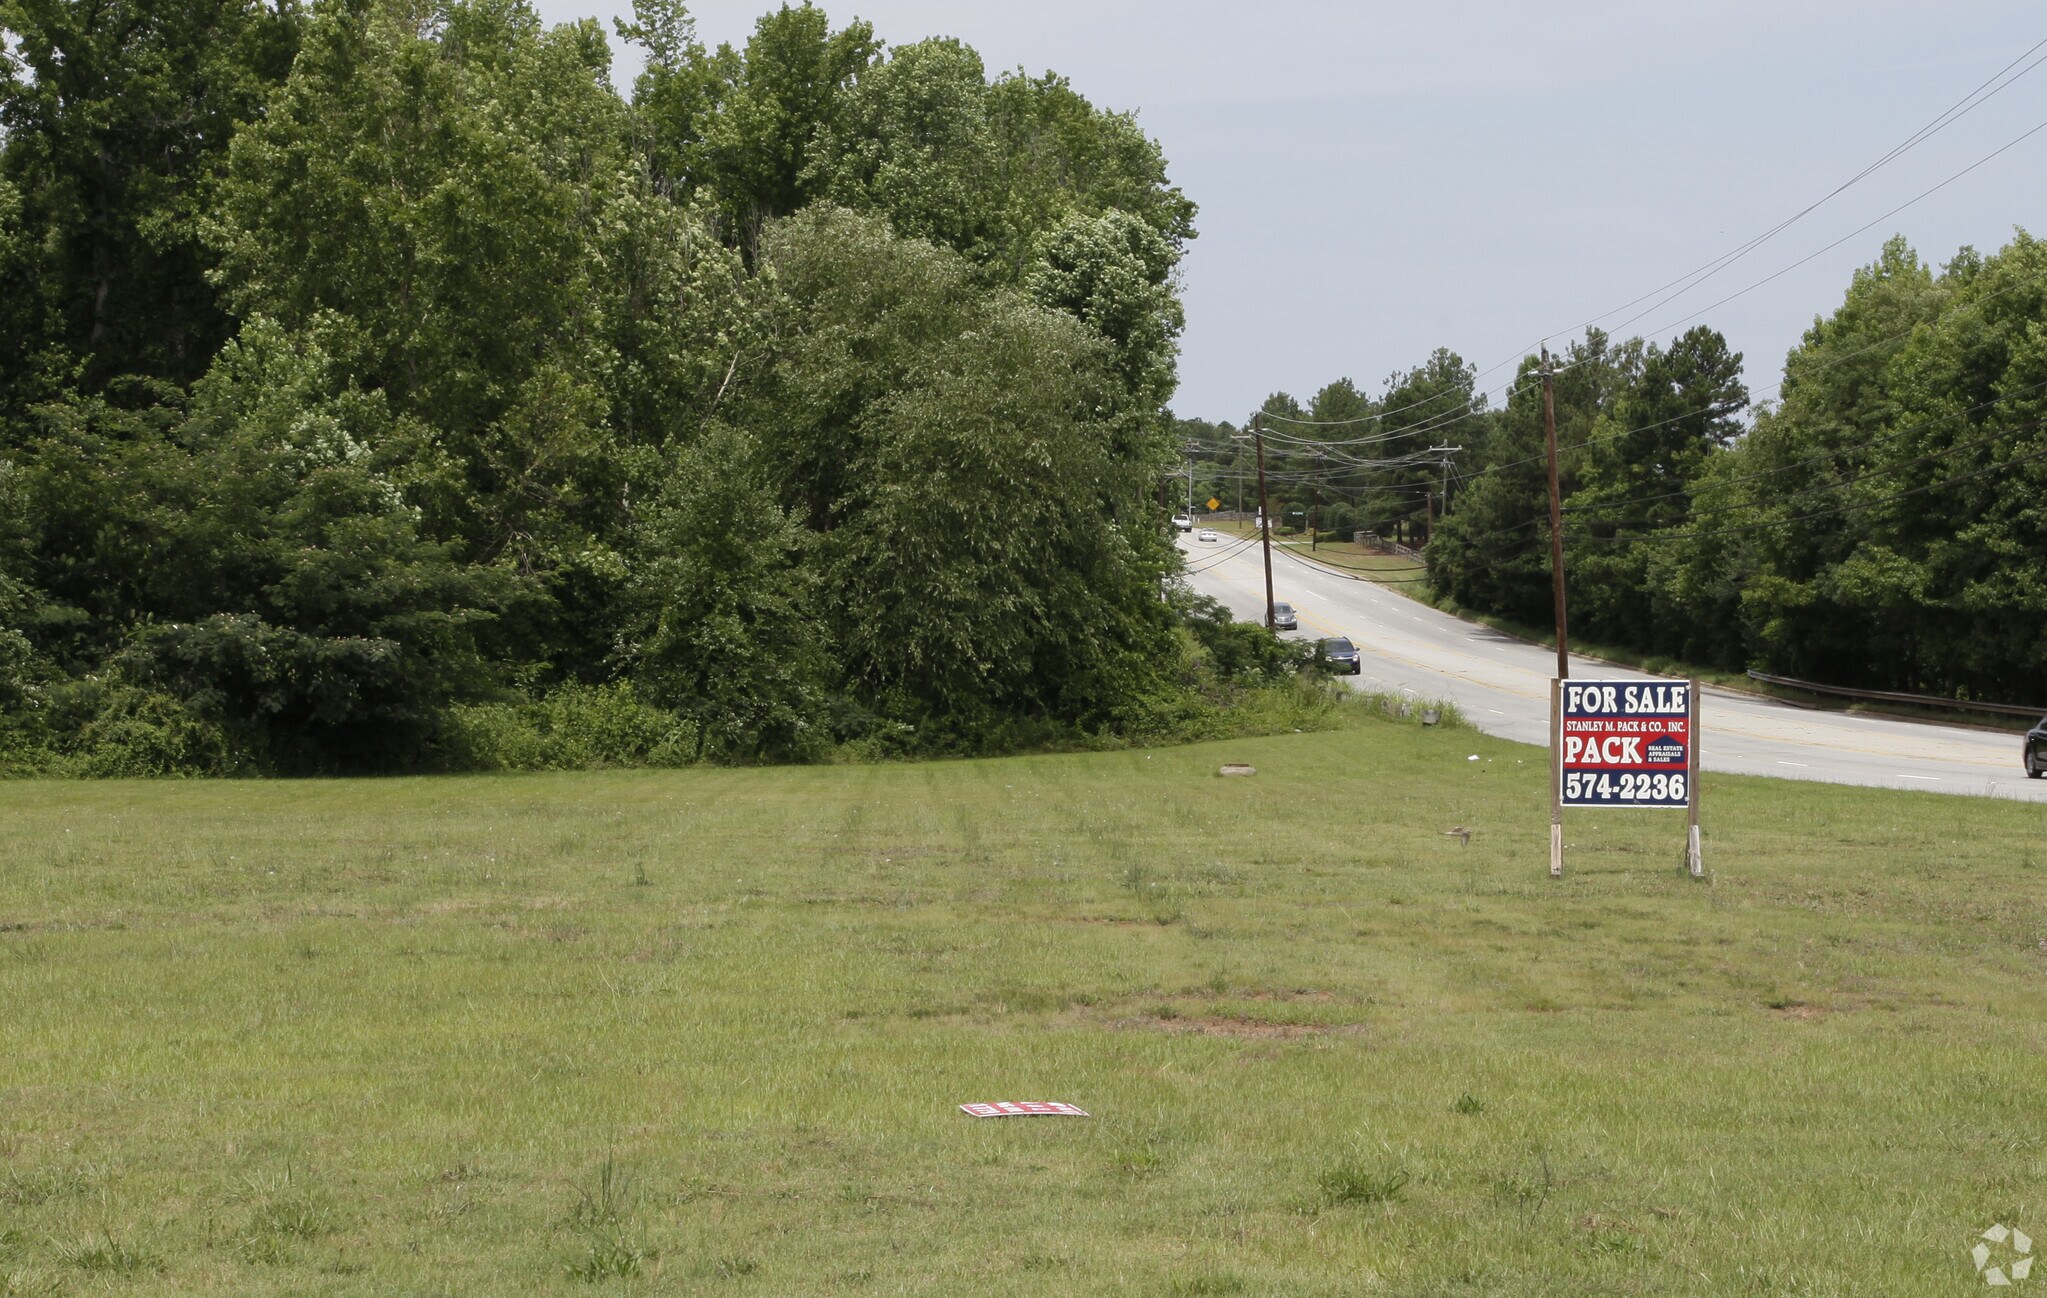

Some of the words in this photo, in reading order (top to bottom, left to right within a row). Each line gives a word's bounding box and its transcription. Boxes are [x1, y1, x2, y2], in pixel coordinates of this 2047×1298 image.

[1567, 686, 1618, 713] FOR
[1624, 686, 1686, 713] SALE
[1566, 721, 1604, 731] STANLEY
[1605, 721, 1616, 731] M.
[1617, 721, 1640, 732] PACK
[1640, 721, 1647, 732] &
[1648, 721, 1666, 733] CO.,
[1667, 722, 1686, 732] INC.
[1565, 736, 1643, 764] PACK
[1566, 772, 1685, 800] 574-2236
